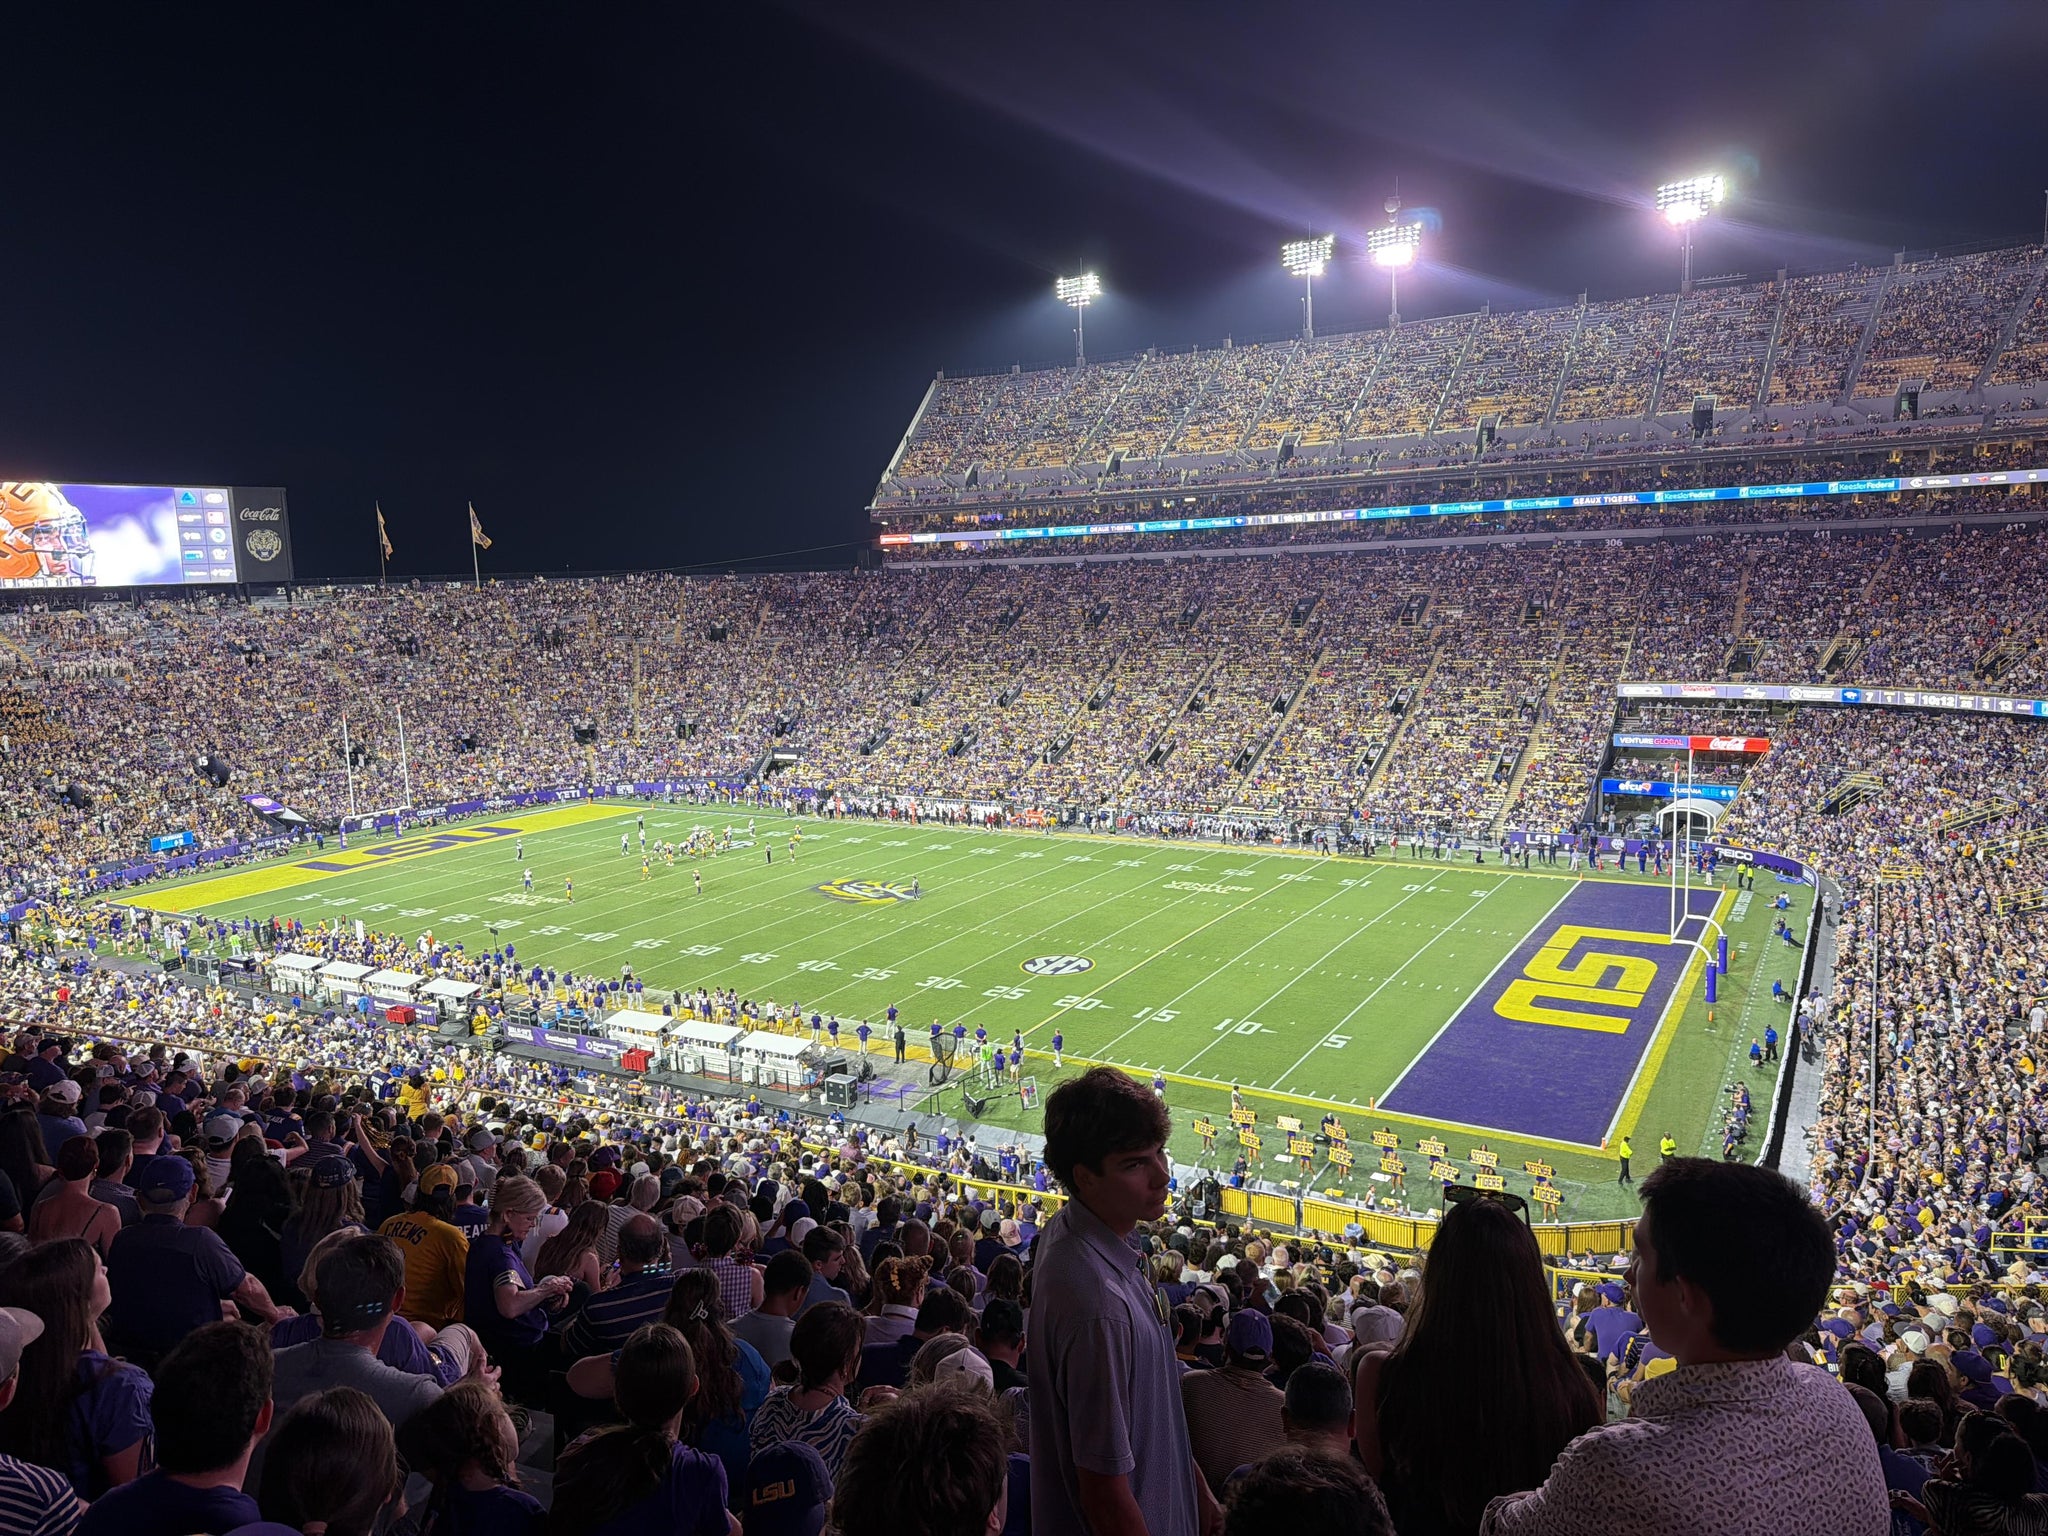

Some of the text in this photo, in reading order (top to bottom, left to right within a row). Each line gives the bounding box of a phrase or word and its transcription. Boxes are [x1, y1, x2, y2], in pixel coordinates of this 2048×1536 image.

[1750, 485, 1803, 495] KeeslerFederal
[1840, 481, 1895, 491] KeeslerFederal
[1573, 496, 1602, 506] GEAUX
[1664, 490, 1716, 500] KeeslerFederal
[1604, 538, 1623, 548] 306
[103, 592, 119, 601] 234
[1865, 692, 1874, 701] 7
[1921, 694, 1955, 707] 10:12
[2000, 700, 2013, 712] 13
[1620, 736, 1685, 746] VENTURE GLOBAL
[1618, 780, 1643, 792] efcu
[556, 790, 580, 799] YETI
[1525, 833, 1559, 846] LSU
[1338, 878, 1373, 888] 15
[1401, 883, 1438, 893] 10
[580, 931, 619, 942] 40
[632, 938, 671, 949] 45
[680, 944, 724, 956] 50
[739, 952, 780, 964] 45
[1024, 955, 1090, 975] SEC
[797, 960, 838, 972] 40
[851, 967, 899, 981] 35
[1493, 924, 1673, 1034] LSU
[915, 976, 963, 990] 30
[982, 985, 1032, 1000] 25
[1053, 995, 1103, 1011] 20
[1132, 1006, 1181, 1022] 15
[1213, 1018, 1264, 1035] 10
[1322, 1034, 1353, 1049] 5
[1232, 1110, 1255, 1124] DEFENSE
[1195, 1121, 1215, 1137] TIGERS
[1241, 1132, 1260, 1147] TIGERS
[1374, 1132, 1397, 1147] DEFENSE
[1292, 1141, 1313, 1155] TIGERS
[1420, 1141, 1445, 1156] DEFENSE
[1330, 1148, 1352, 1165] TIGERS
[1472, 1150, 1497, 1166] DEFENSE
[1433, 1162, 1457, 1180] TIGERS
[1526, 1162, 1552, 1177] DEFENSE
[1478, 1175, 1503, 1189] TIGERS
[1535, 1187, 1560, 1203] TIGERS
[384, 1221, 427, 1246] CREWS
[752, 1479, 796, 1505] LSU
